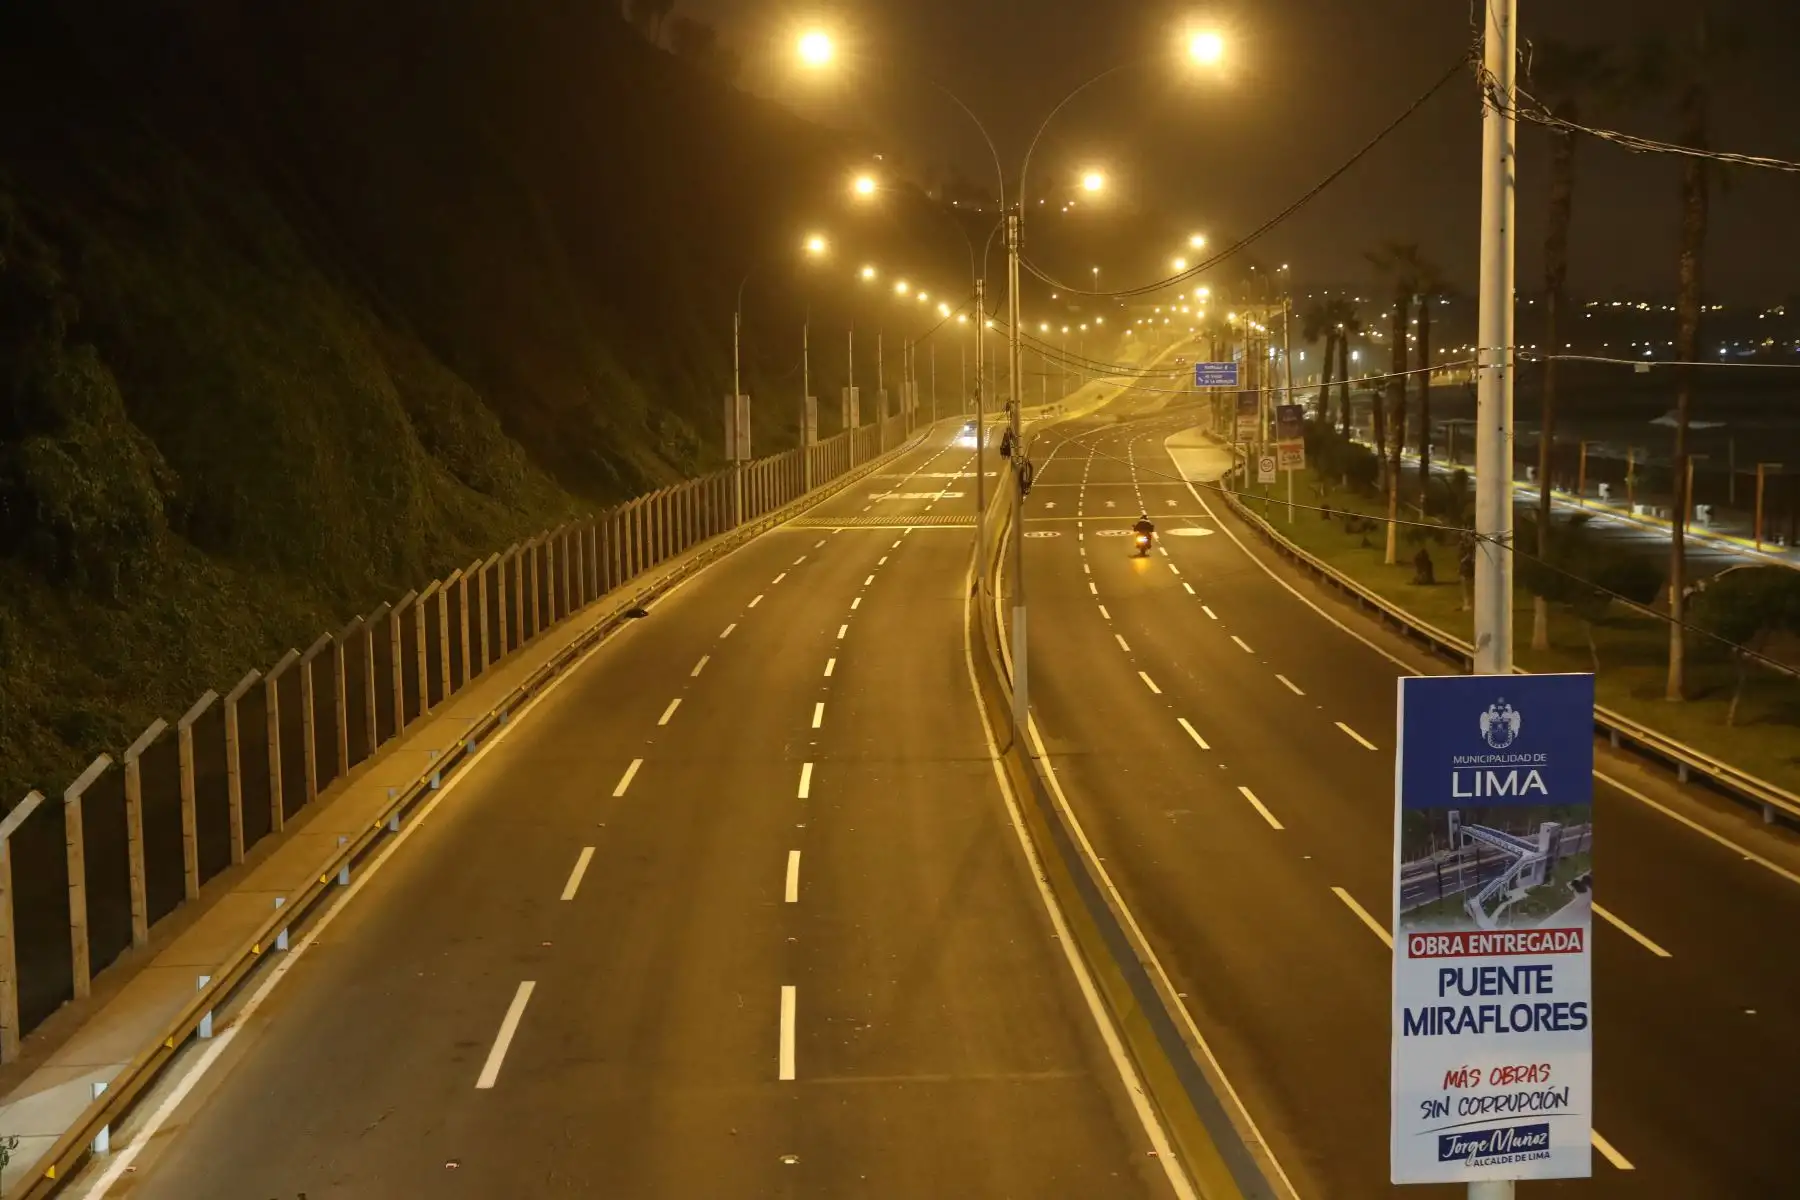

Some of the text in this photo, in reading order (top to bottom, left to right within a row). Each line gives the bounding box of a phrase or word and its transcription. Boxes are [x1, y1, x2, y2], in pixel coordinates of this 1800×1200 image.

[1453, 754, 1547, 764] MUNICIPALIDAD DE
[1452, 770, 1548, 797] LIMA
[1411, 931, 1581, 956] OBRA ENTREGADA
[1439, 965, 1553, 997] PUENTE
[1403, 1002, 1587, 1036] MIRAFLORES
[1443, 1064, 1551, 1090] MÁS OBRAS
[1420, 1086, 1569, 1119] SIN CORRUPCIÓN
[1442, 1129, 1546, 1166] Jorge Muñoz
[1474, 1152, 1550, 1166] ALCALDE DE LIMA
